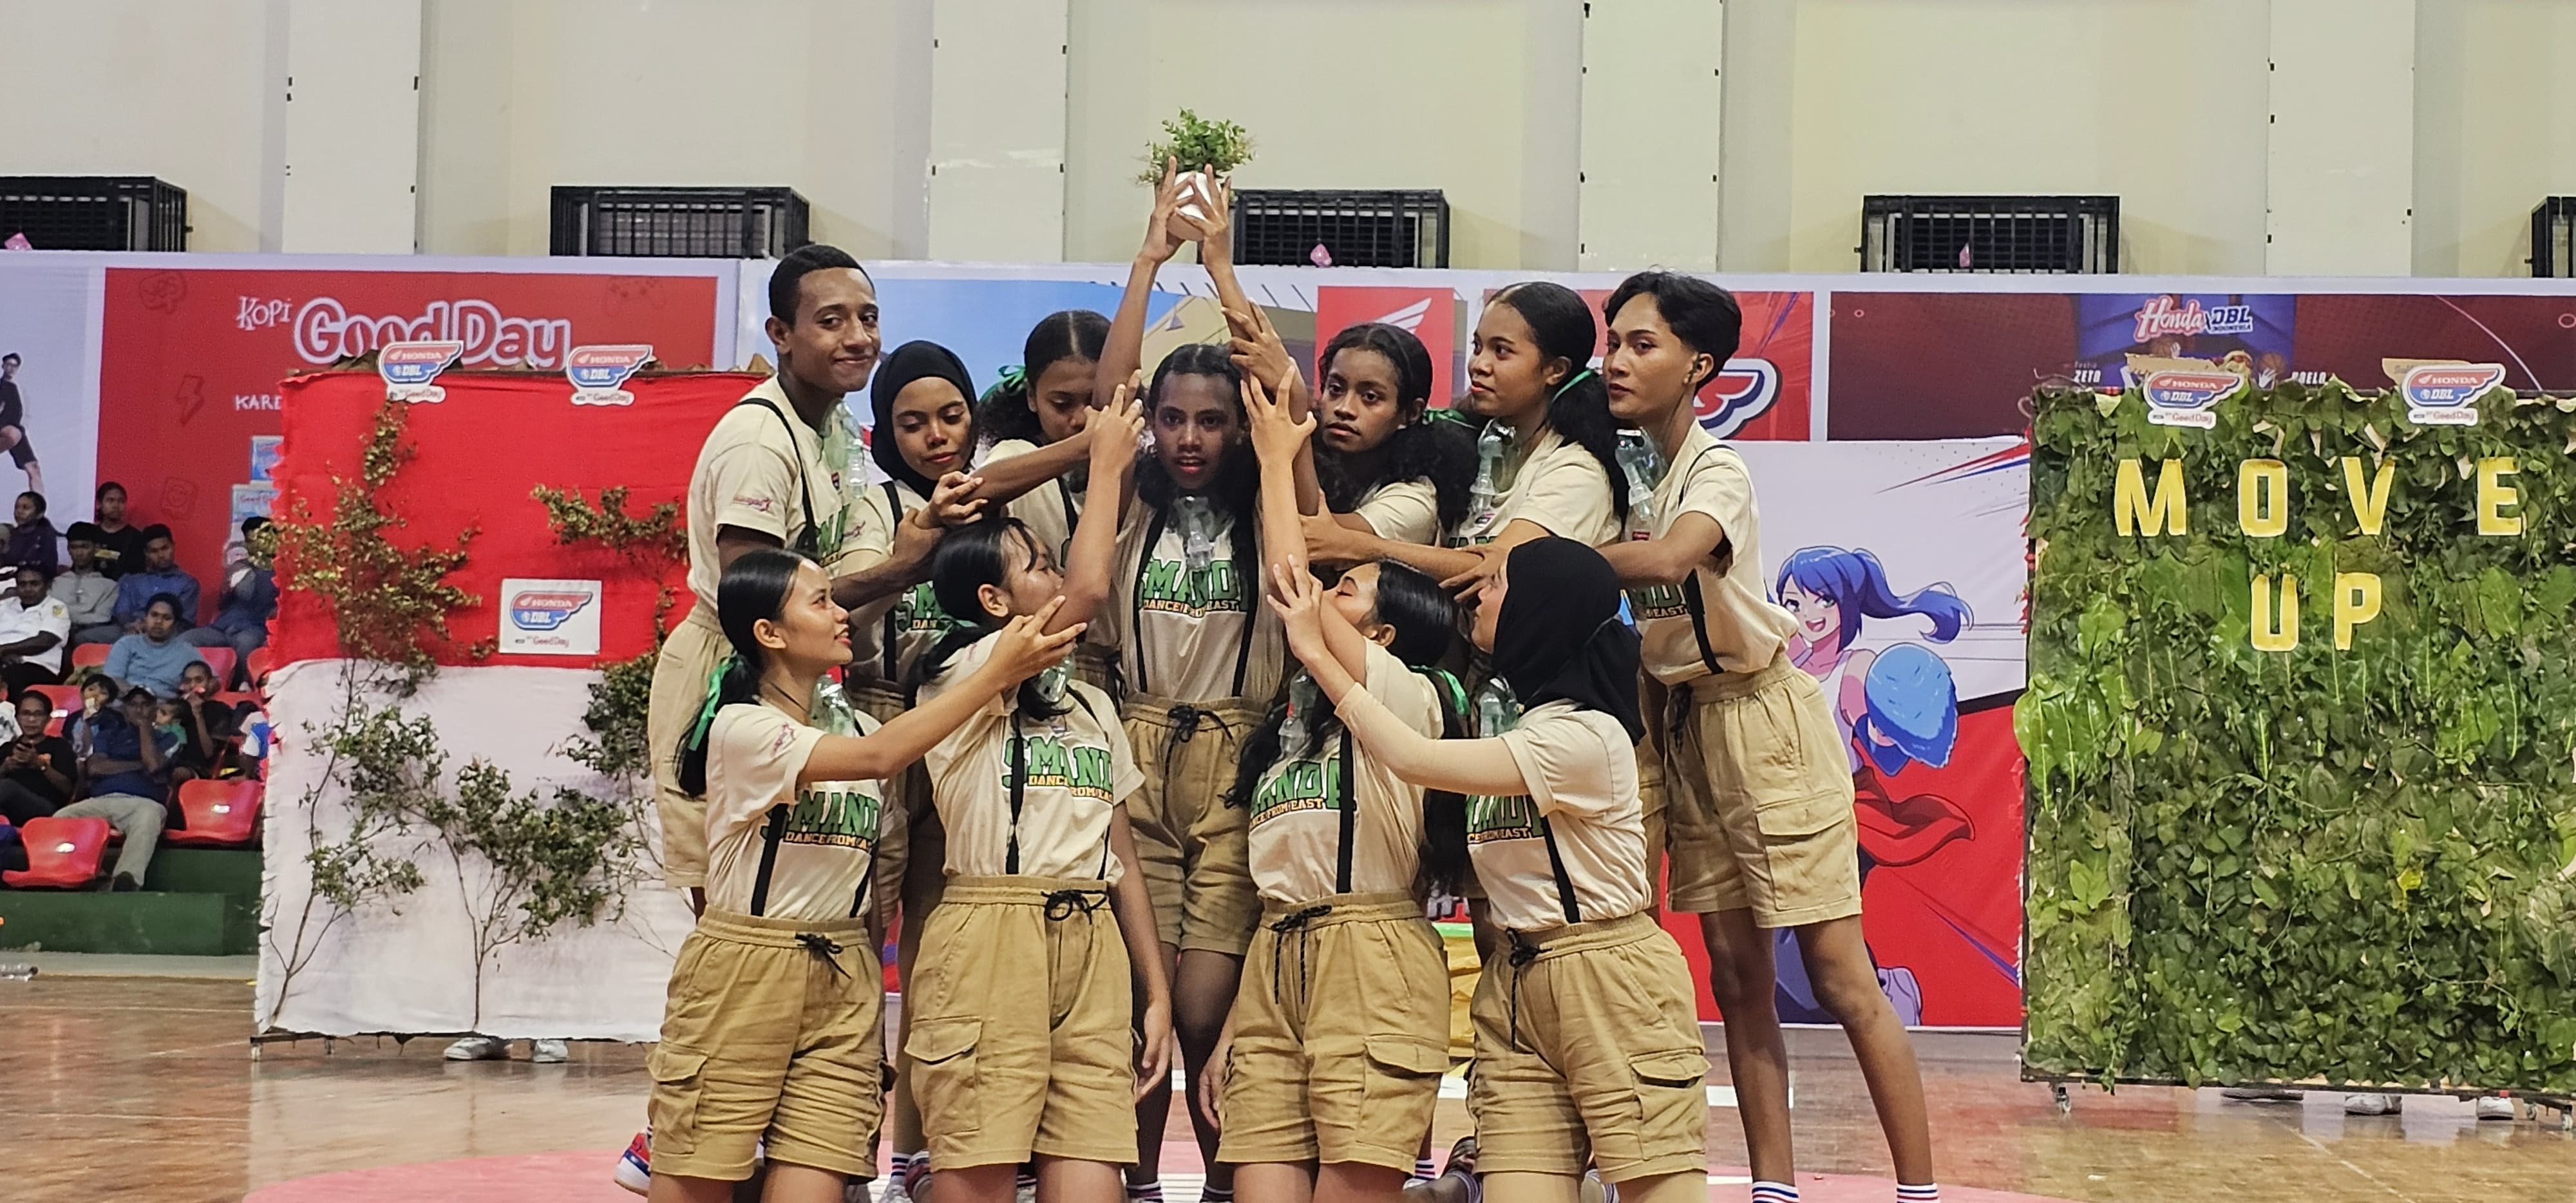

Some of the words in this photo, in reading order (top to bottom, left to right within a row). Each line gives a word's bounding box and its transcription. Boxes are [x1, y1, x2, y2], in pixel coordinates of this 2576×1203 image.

[2135, 296, 2206, 341] Honda
[2211, 307, 2251, 325] DBL
[401, 352, 442, 360] HONDA
[589, 355, 631, 364] HONDA
[2172, 380, 2218, 389] HONDA
[2431, 376, 2479, 384] HONDA
[2170, 391, 2193, 402] DBL
[2430, 388, 2454, 400] DBL
[2114, 456, 2523, 538] MOVE
[531, 599, 573, 607] HONDA
[1652, 605, 1685, 618] EAST
[2251, 572, 2382, 652] UP
[1290, 798, 1323, 811] EAST
